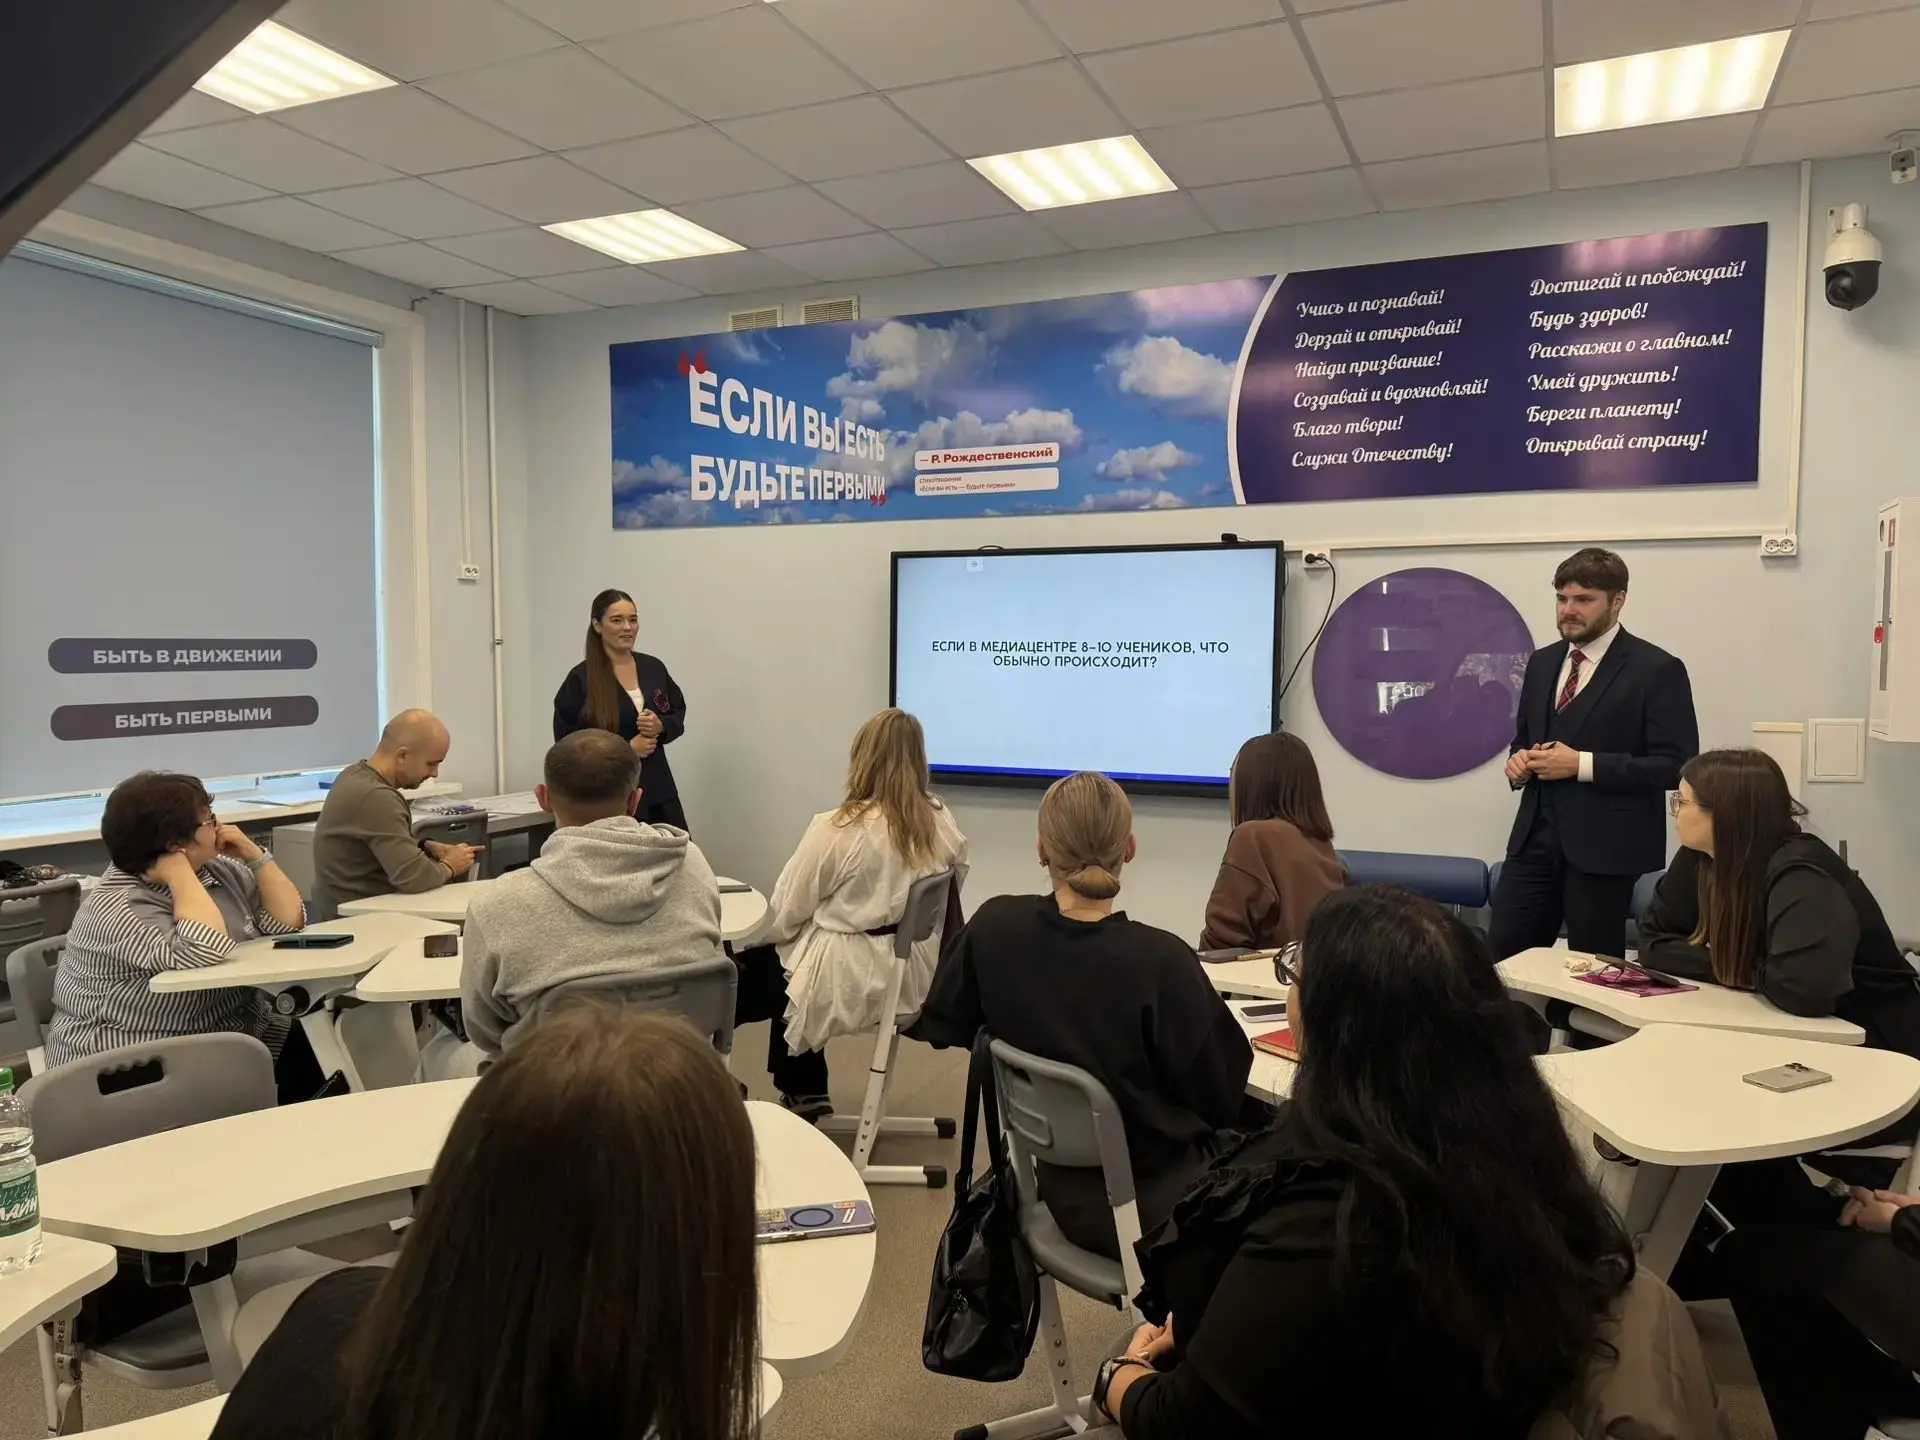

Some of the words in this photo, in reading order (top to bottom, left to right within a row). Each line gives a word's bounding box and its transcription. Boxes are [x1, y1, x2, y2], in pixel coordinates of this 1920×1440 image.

[1529, 272, 1622, 296] Достигай
[1625, 274, 1637, 287] и
[1640, 260, 1747, 286] побеждай!
[1296, 301, 1344, 318] Учись
[1347, 301, 1358, 313] и
[1360, 289, 1445, 314] познавай!
[1529, 309, 1575, 331] Будь
[1578, 302, 1649, 328] здоров!
[1294, 328, 1353, 350] Дерзай
[1355, 330, 1366, 342] и
[1368, 319, 1463, 343] открывай!
[1528, 340, 1622, 359] Расскажи
[1625, 339, 1636, 353] о
[1640, 329, 1733, 352] главном!
[1294, 360, 1347, 380] Найди
[1348, 351, 1443, 377] призвание!
[1527, 372, 1576, 391] Умей
[1578, 366, 1679, 392] дружить!
[1293, 388, 1368, 411] Создавай
[1370, 390, 1381, 402] и
[1383, 378, 1489, 405] вдохновляй!
[1526, 405, 1586, 426] Береги
[1588, 399, 1682, 420] планету!
[803, 405, 840, 453] ВЫ
[844, 420, 886, 462] ЕСТЬ
[1292, 422, 1342, 438] Благо
[1344, 415, 1404, 436] твори!
[931, 454, 941, 464] Р.
[943, 447, 1054, 463] Рождественский
[1291, 450, 1348, 470] Служи
[1351, 443, 1454, 464] Отечеству!
[1525, 433, 1625, 456] Открывай
[1627, 430, 1709, 452] страну!
[690, 454, 805, 509] БУДЬТЕ
[93, 649, 153, 664] БЫТЬ
[157, 650, 170, 664] В
[173, 649, 282, 665] ДВИЖЕНИИ
[932, 640, 965, 653] ЕСЛИ
[969, 640, 978, 653] В
[980, 640, 1077, 655] МЕДИАЦЕНТРЕ
[1116, 641, 1196, 655] УЧЕНИКОВ,
[1200, 641, 1229, 653] ЧТО
[993, 655, 1050, 668] ОБЫЧНО
[1054, 655, 1157, 669] ПРОИСХОДИТ?
[115, 713, 173, 729] БЫТЬ
[176, 707, 272, 726] ПЕРВЫМИ
